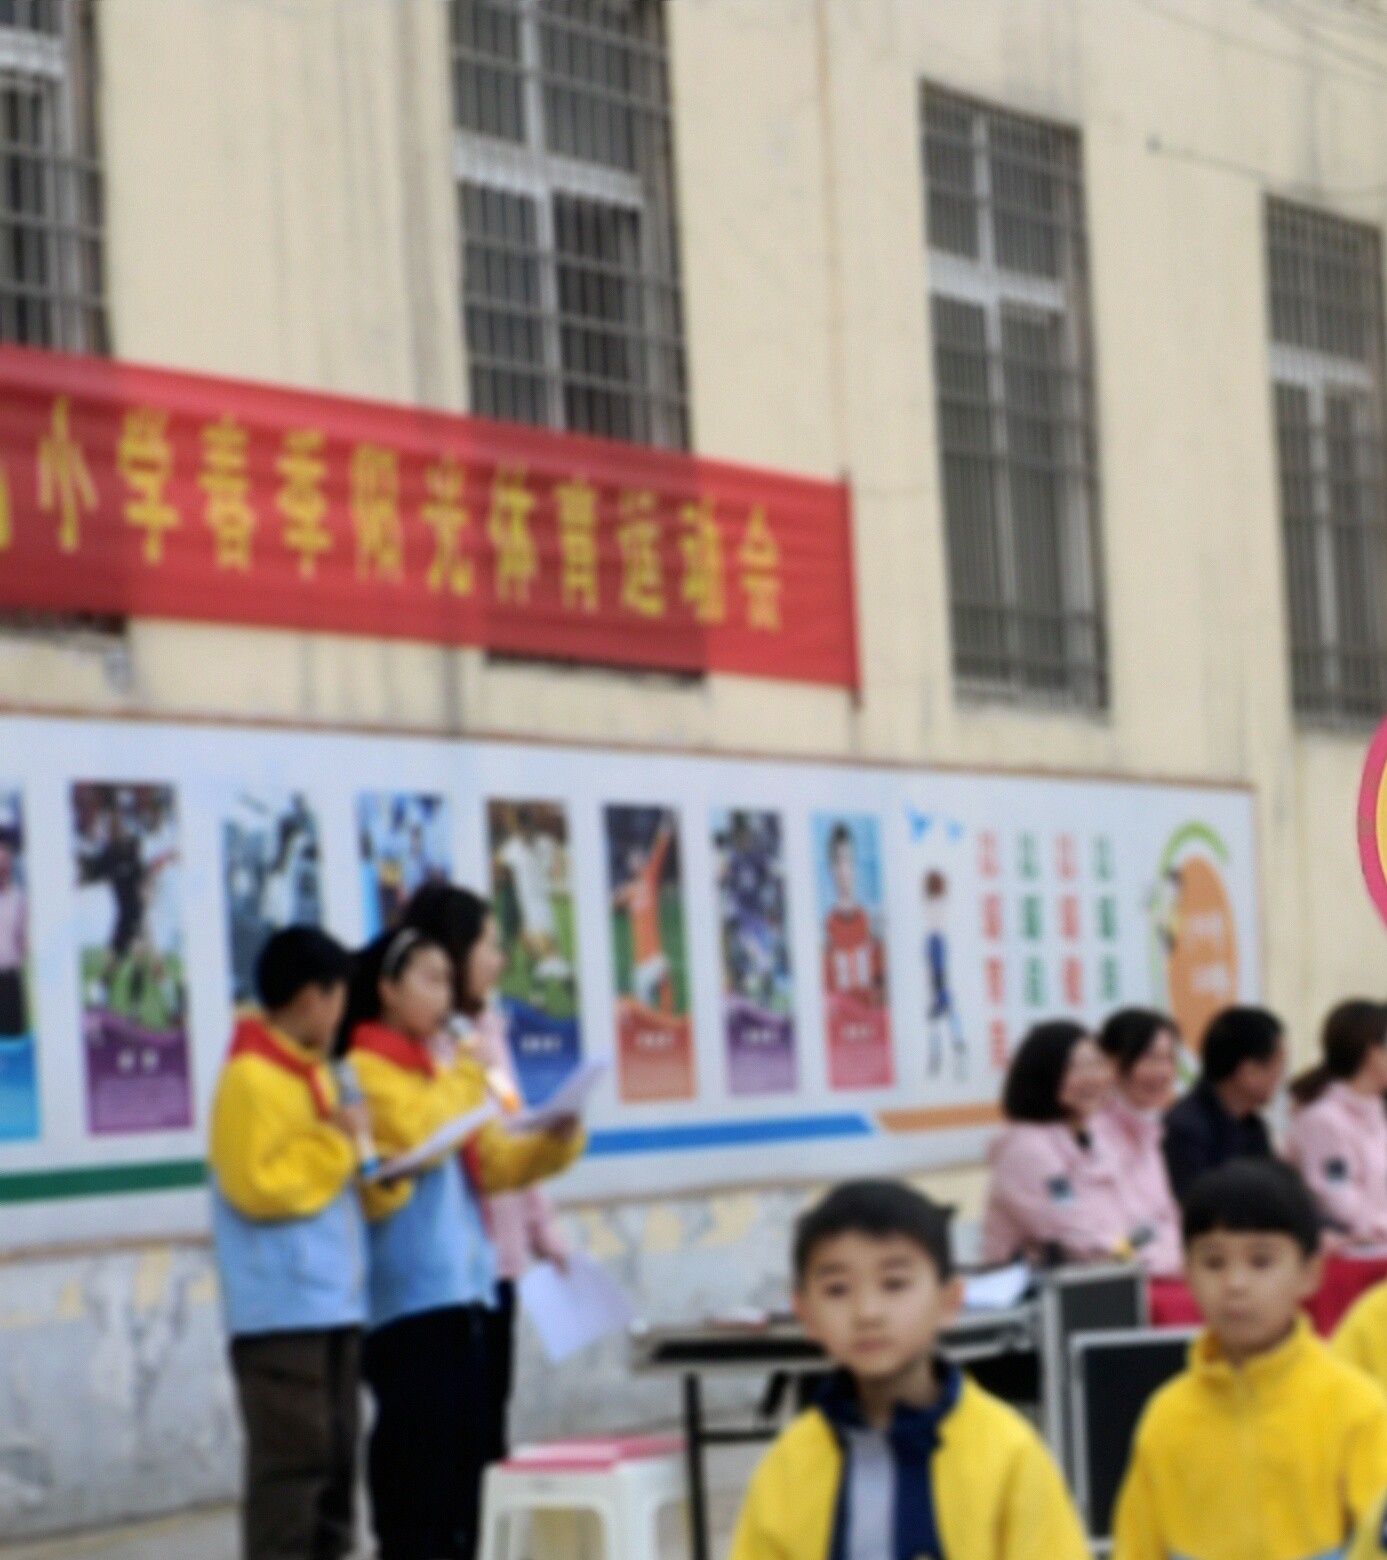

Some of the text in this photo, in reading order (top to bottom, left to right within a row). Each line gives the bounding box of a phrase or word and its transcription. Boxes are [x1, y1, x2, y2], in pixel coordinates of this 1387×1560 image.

[0, 395, 784, 632] 小学春季阳光体育运动会
